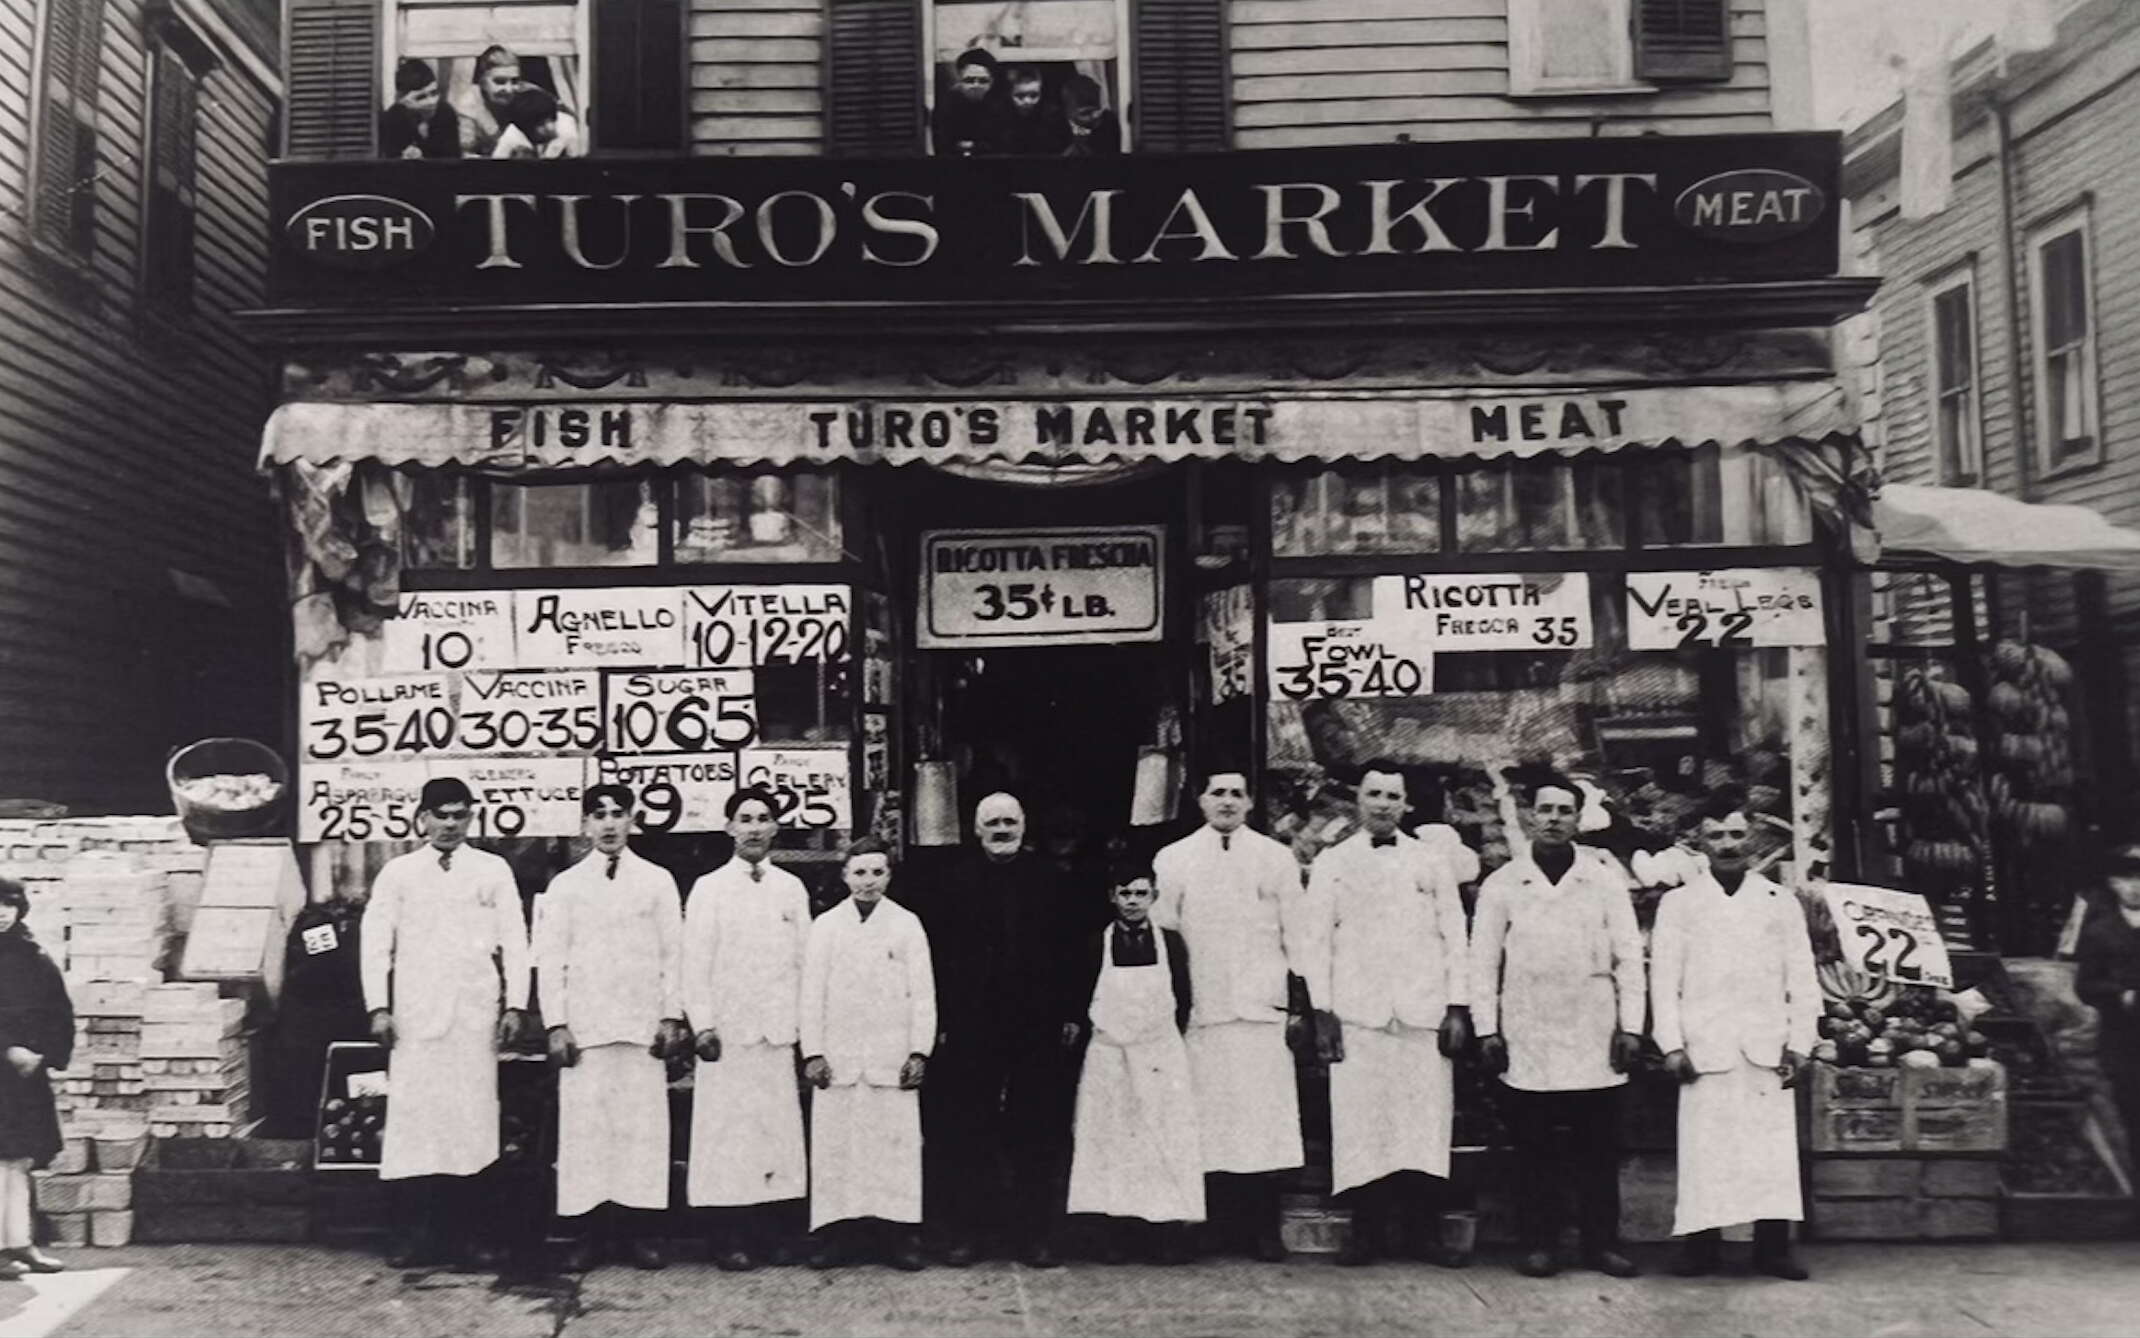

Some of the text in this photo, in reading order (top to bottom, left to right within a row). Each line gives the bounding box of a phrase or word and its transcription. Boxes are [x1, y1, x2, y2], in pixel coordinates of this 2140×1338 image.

[455, 174, 1658, 269] TURO'S MARKET
[1692, 188, 1811, 227] MEAT
[307, 217, 413, 250] FISH
[490, 409, 632, 449] FISH
[809, 405, 1274, 448] TURO'S MARKET
[1470, 400, 1627, 442] MEAT
[399, 594, 499, 619] VACCINA
[688, 589, 847, 616] VITELLA
[1063, 595, 1116, 618] LB.
[1402, 575, 1540, 609] RICOTTA
[1627, 584, 1725, 617] VEAL
[527, 594, 675, 633] AGNELLO
[1532, 617, 1579, 646] 35
[1676, 613, 1753, 649] 22
[422, 631, 473, 671] 10
[1302, 636, 1398, 663] FOWL
[316, 681, 442, 706] POLLAME
[464, 672, 587, 700] VACCINA
[625, 675, 728, 697] SUGAR
[1276, 660, 1421, 699] 35-40
[308, 706, 454, 760] 35-40
[460, 706, 602, 750] 30-35
[600, 757, 736, 786] POTATOES
[748, 766, 847, 791] CELERY
[308, 781, 420, 806] ASPARAGU
[472, 786, 582, 805] ETTUCE
[479, 804, 526, 837] 10
[1856, 924, 1921, 981] 22
